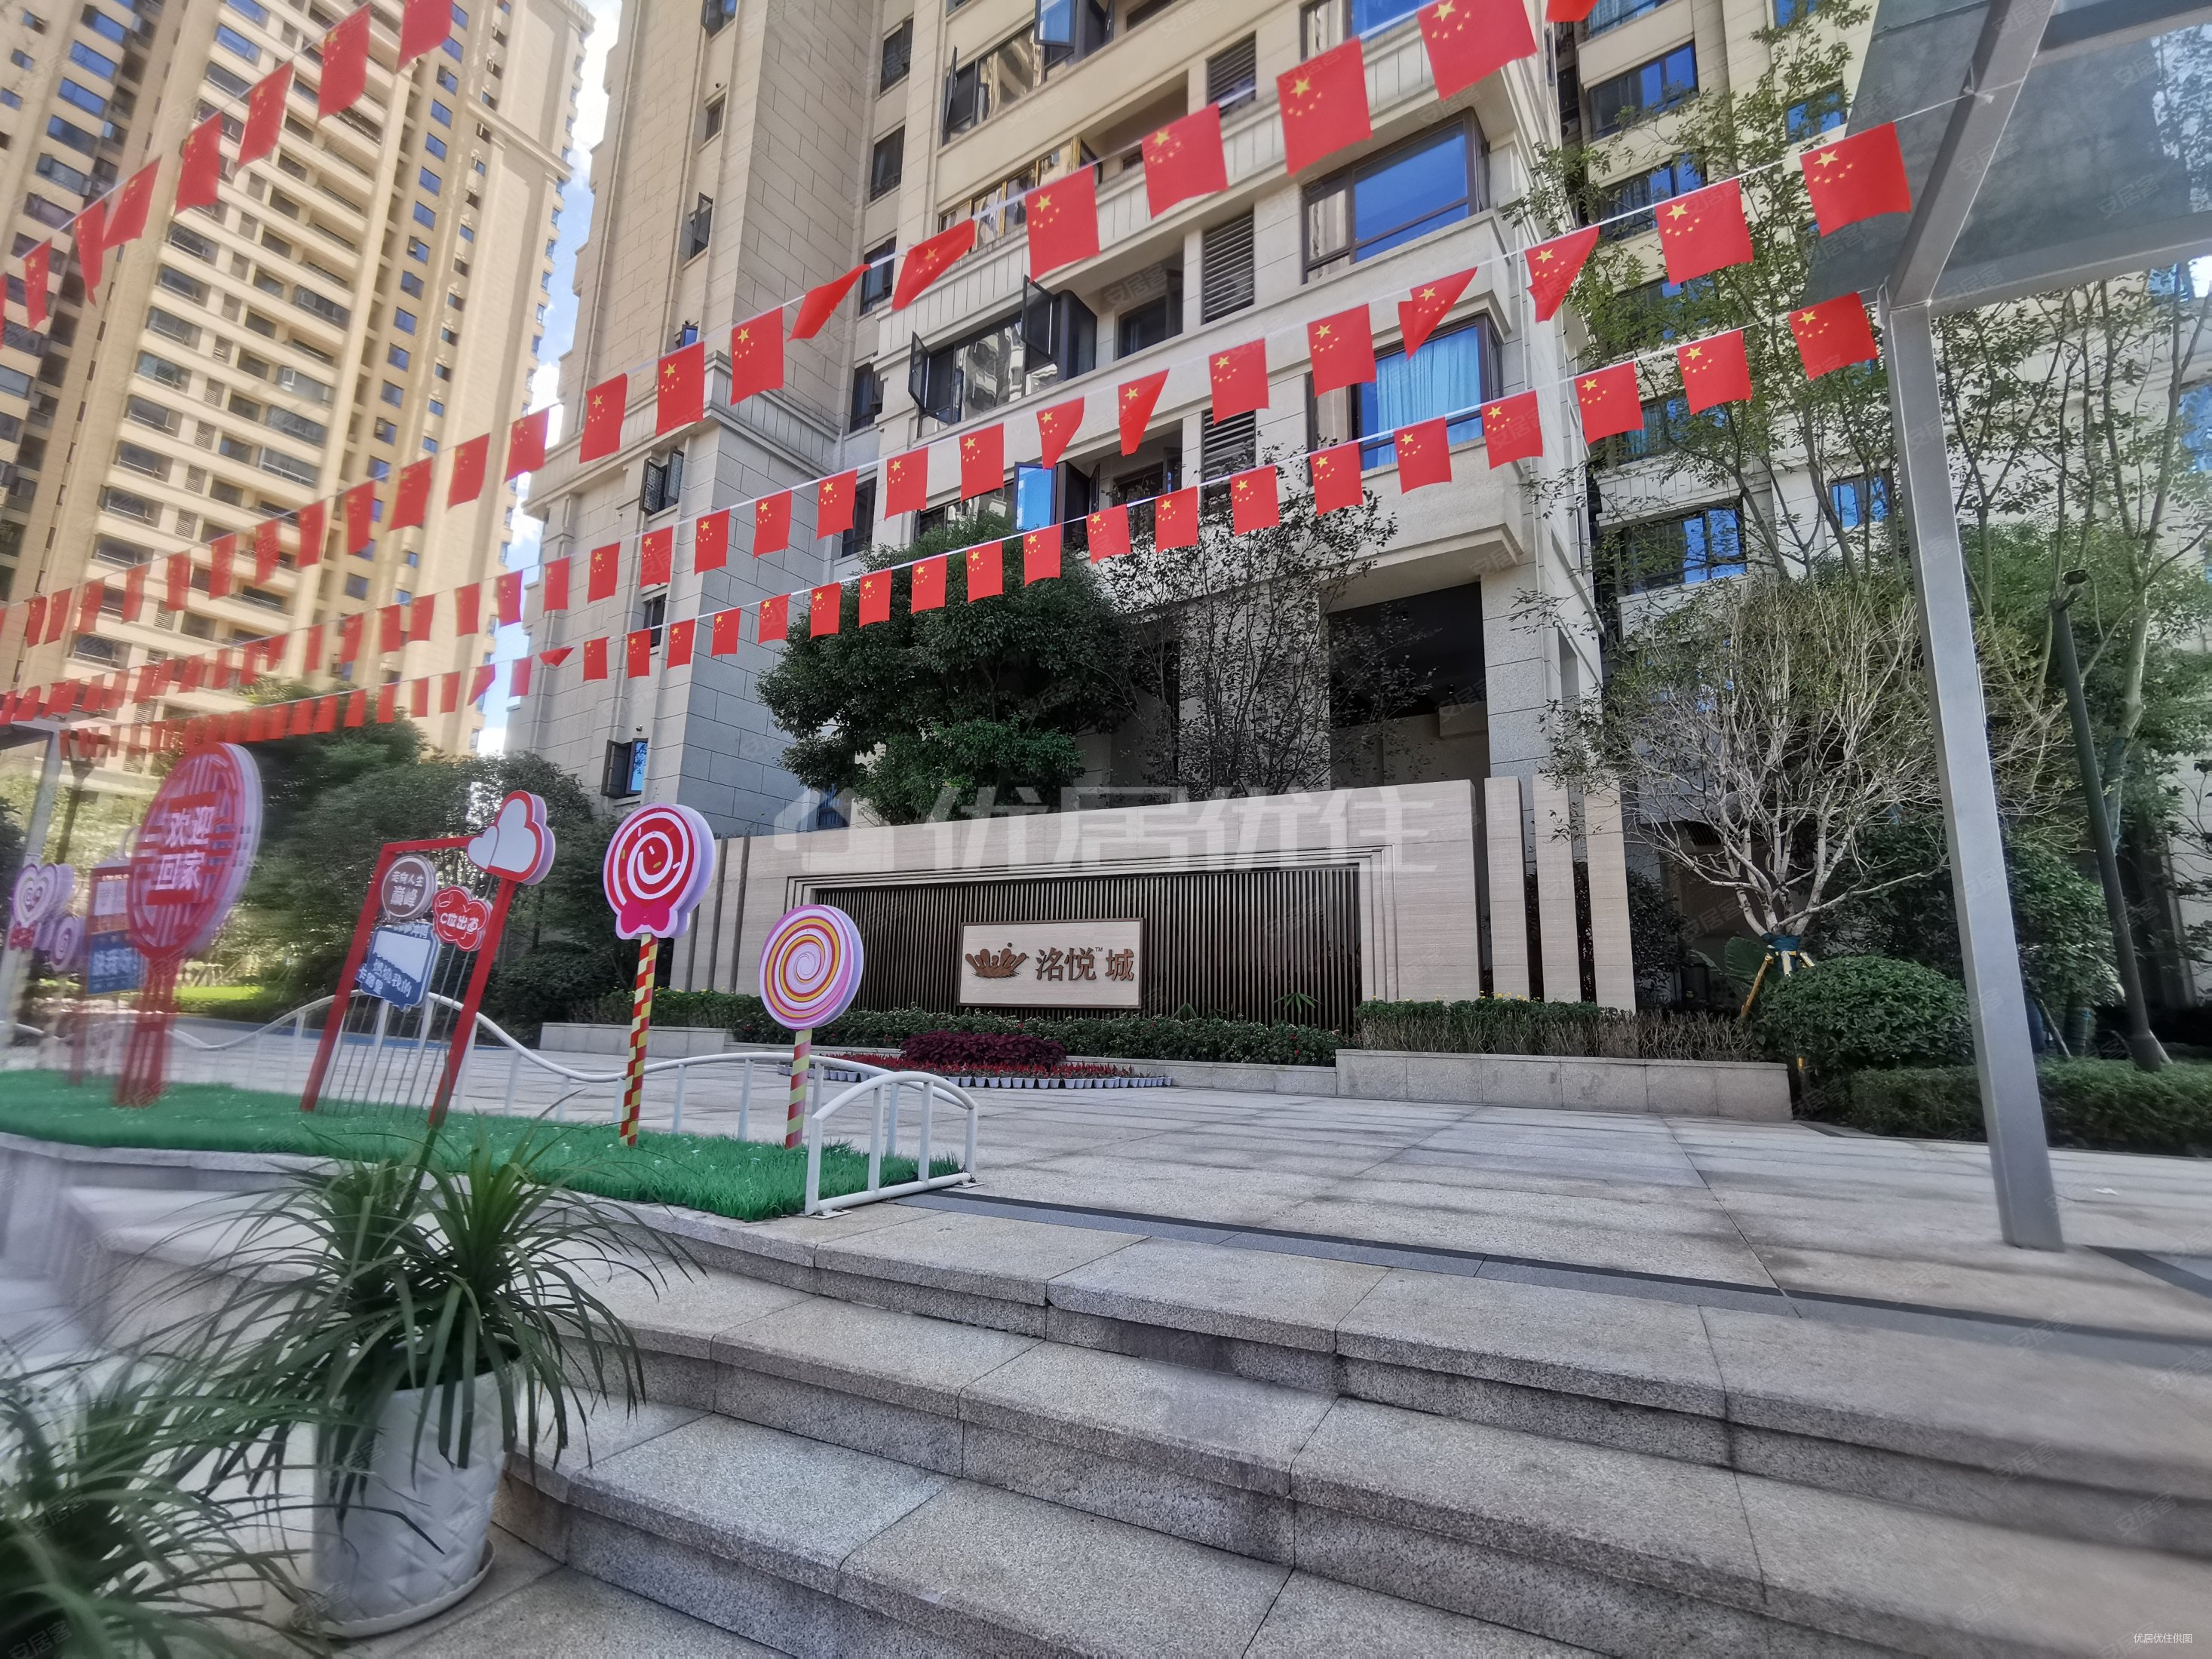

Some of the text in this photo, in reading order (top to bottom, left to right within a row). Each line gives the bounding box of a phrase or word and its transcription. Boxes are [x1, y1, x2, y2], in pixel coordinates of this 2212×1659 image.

[165, 805, 216, 848] 欢迎
[155, 849, 206, 891] 回家
[391, 870, 425, 888] 走向人生
[389, 885, 419, 908] 巅峰
